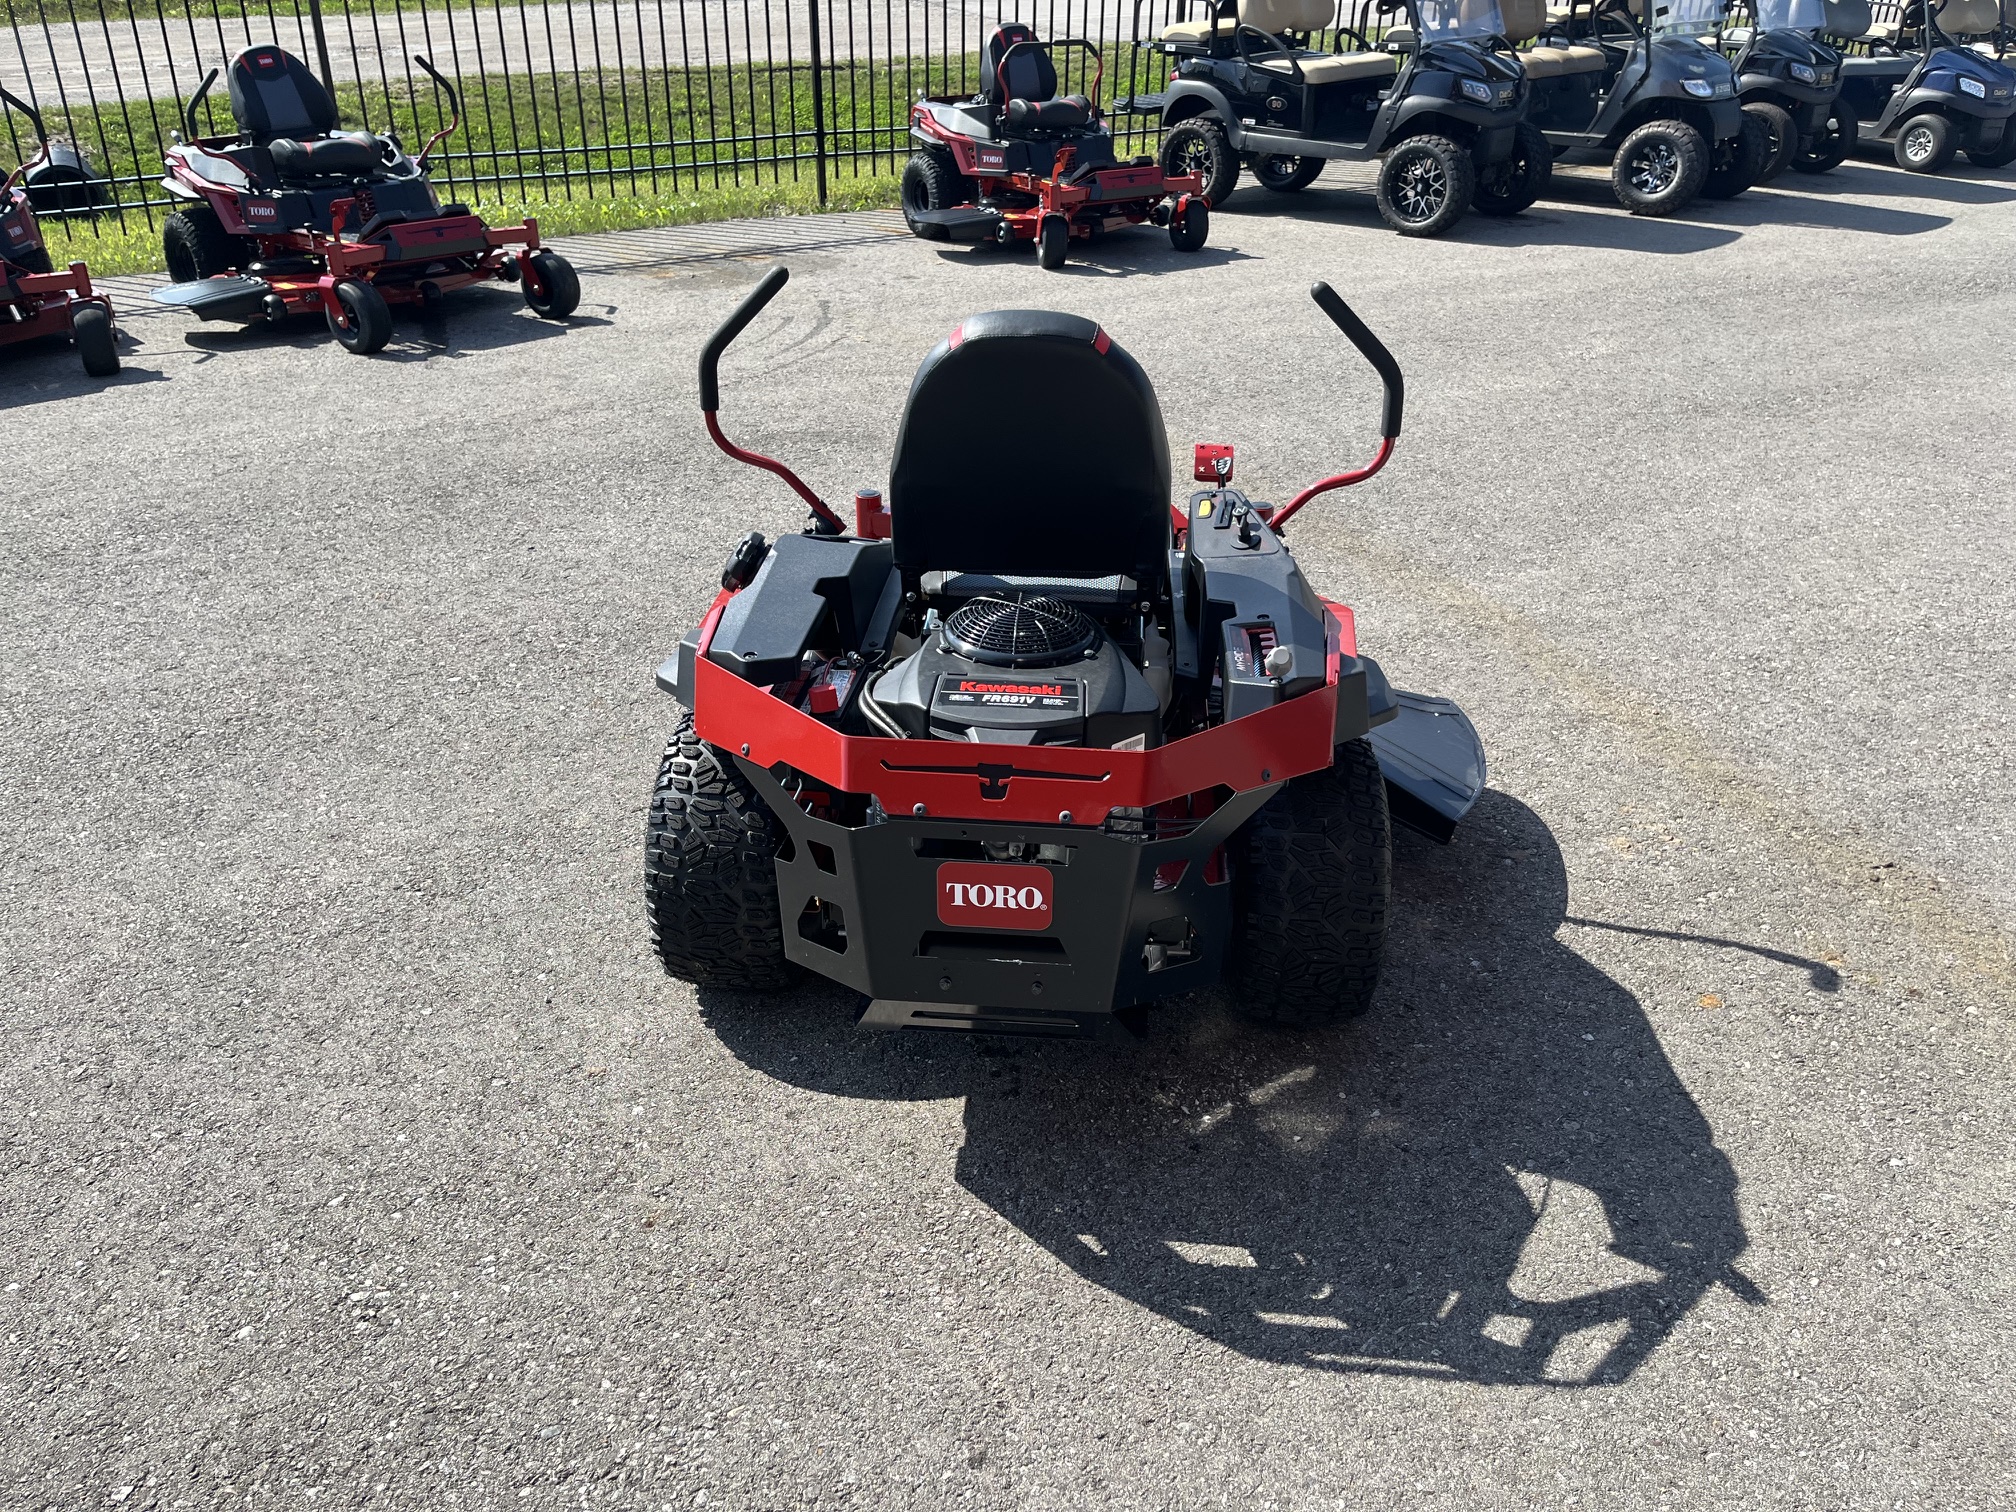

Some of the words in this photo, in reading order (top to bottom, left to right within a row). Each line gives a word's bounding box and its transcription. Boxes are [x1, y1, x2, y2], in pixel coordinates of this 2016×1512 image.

[1271, 100, 1282, 108] 90
[249, 207, 275, 216] TORO
[959, 681, 1062, 695] Kawasaki
[981, 694, 1037, 704] FR691V
[946, 883, 1043, 910] TORO
